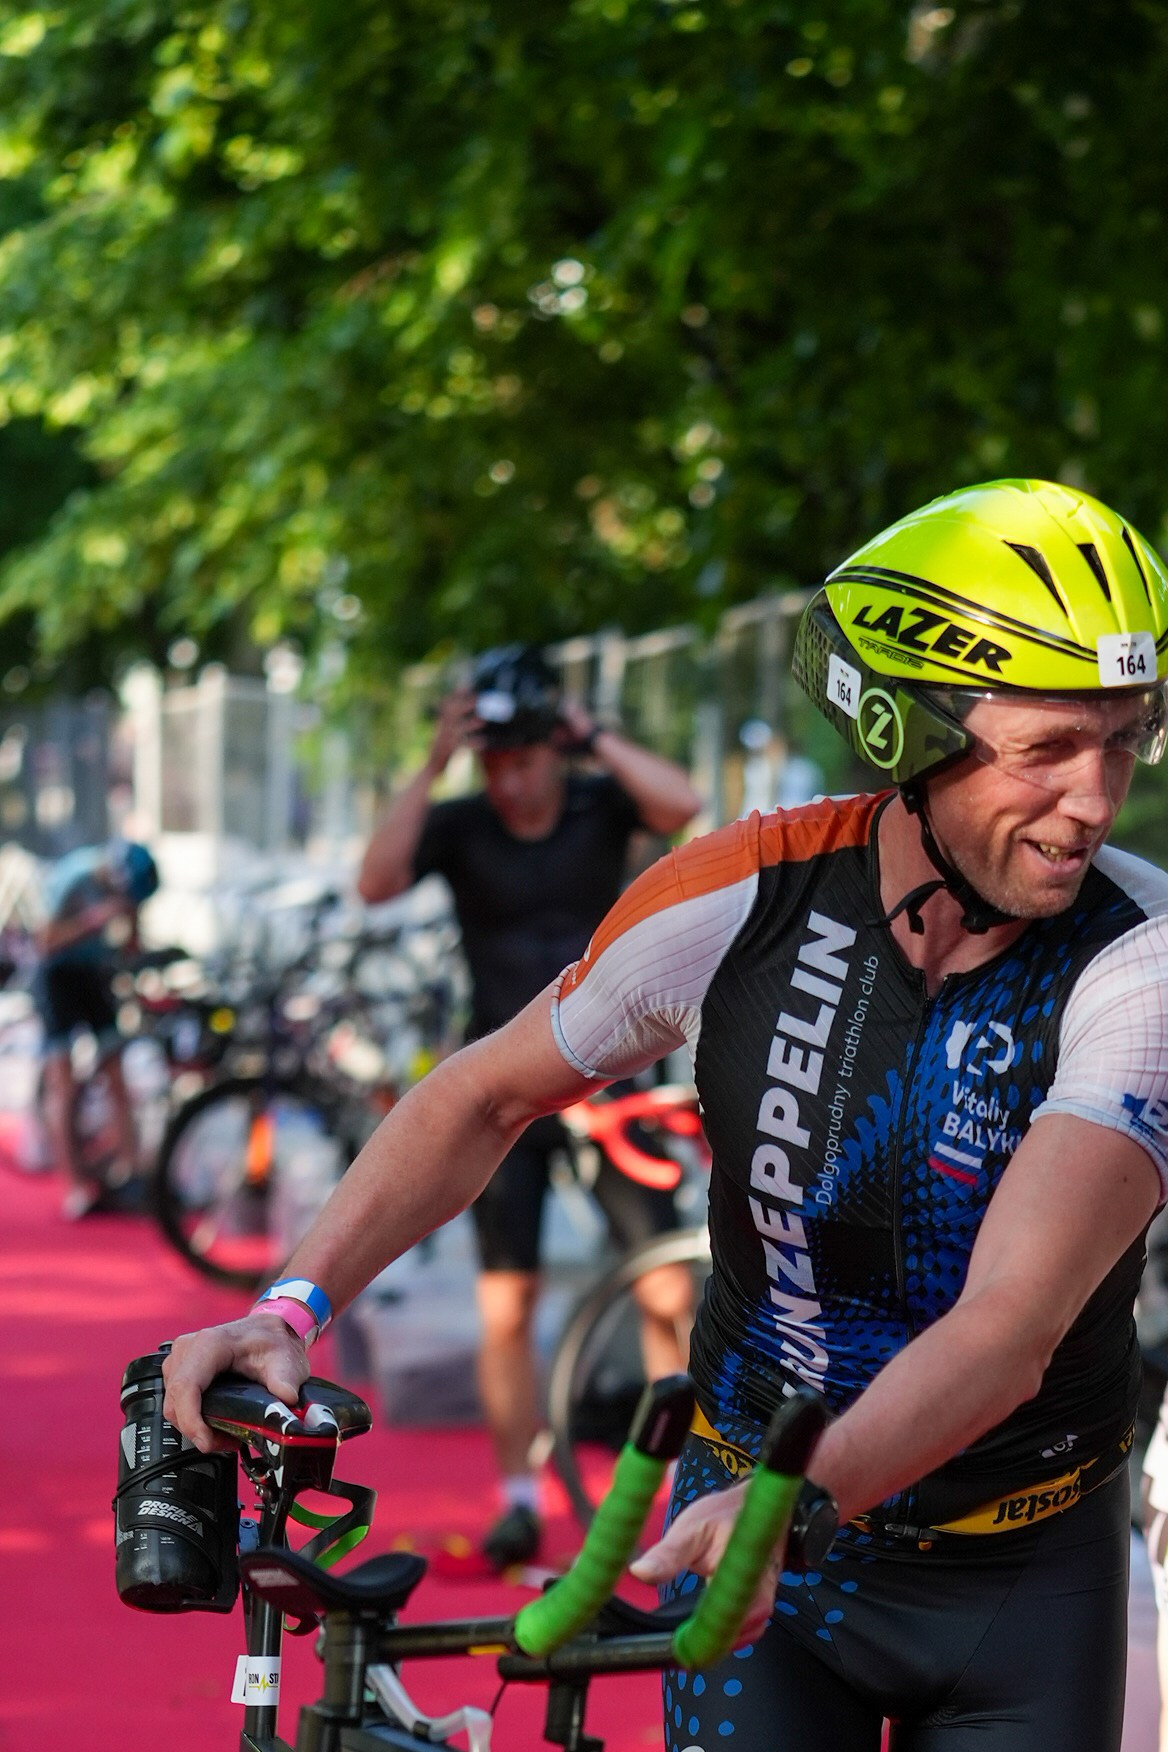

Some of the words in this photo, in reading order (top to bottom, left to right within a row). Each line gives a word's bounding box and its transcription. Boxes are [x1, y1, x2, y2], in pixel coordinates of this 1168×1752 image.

[851, 605, 1012, 675] LAZER
[1116, 653, 1146, 676] 164
[836, 679, 851, 707] 164
[815, 1082, 851, 1206] Dolgoprudny
[838, 998, 870, 1078] triathlon
[861, 955, 879, 997] club
[952, 1080, 1011, 1131] Vitaliy
[137, 1507, 192, 1527] DESIGN
[139, 1500, 199, 1523] PROFILE
[248, 1673, 260, 1685] RON
